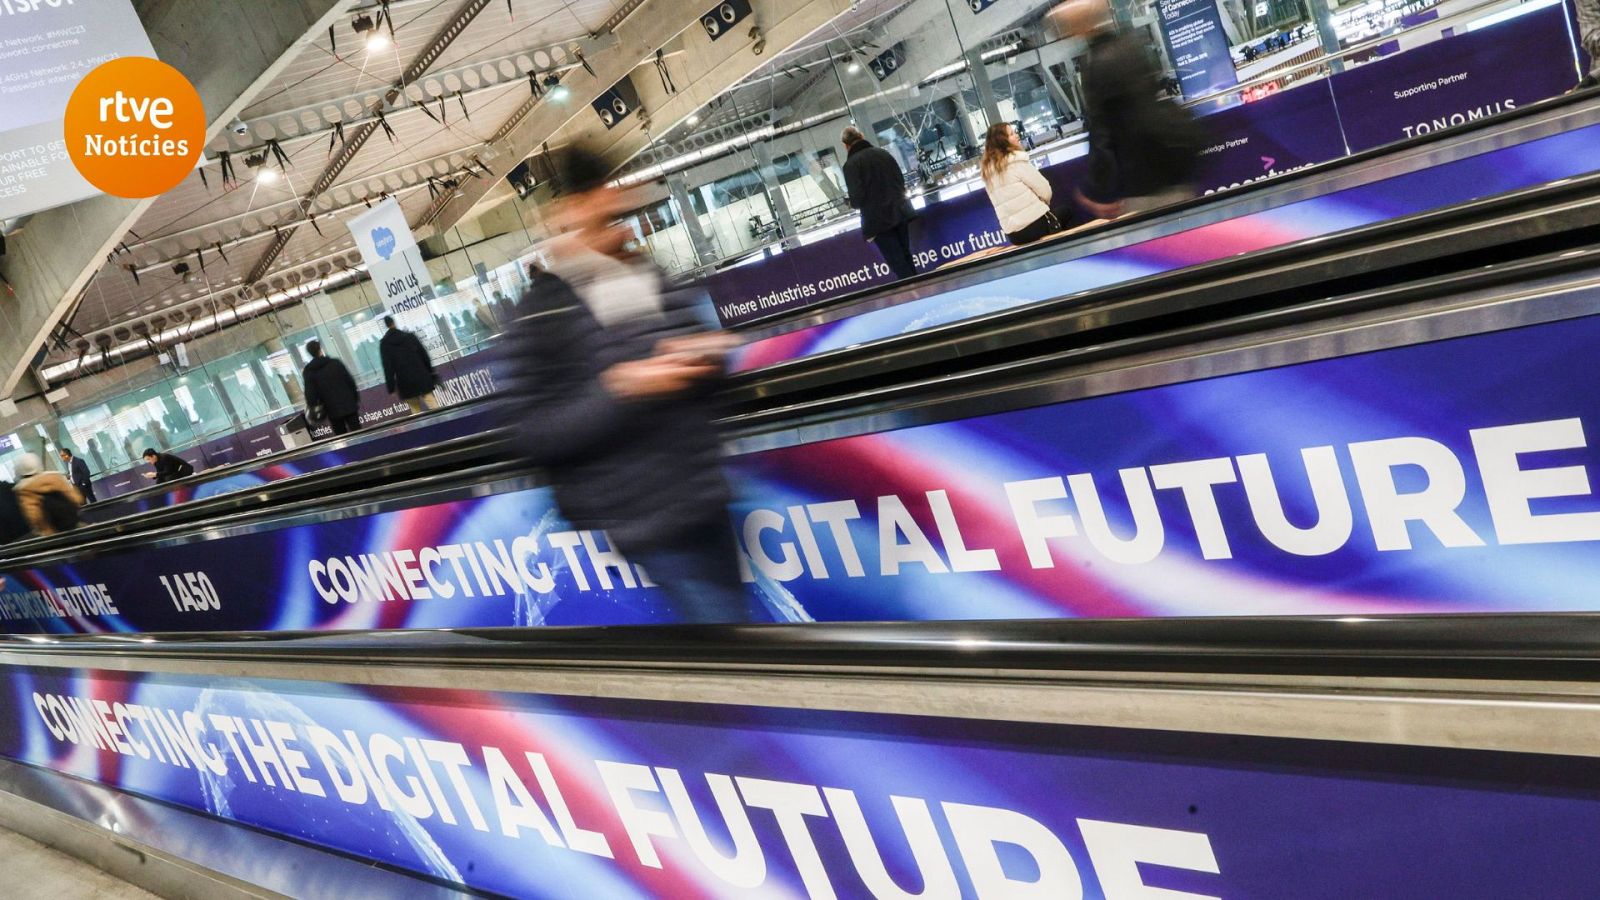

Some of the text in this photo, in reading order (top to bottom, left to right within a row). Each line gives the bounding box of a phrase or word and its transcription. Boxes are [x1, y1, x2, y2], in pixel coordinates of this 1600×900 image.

[32, 38, 80, 52] connectme
[1394, 72, 1468, 99] Supporting Partner
[28, 144, 46, 155] TO
[1226, 136, 1248, 148] Partner
[18, 167, 48, 181] FREE
[385, 272, 419, 298] Join us
[720, 229, 1007, 320] Where industries connect to ape our futur
[364, 410, 382, 423] shape
[382, 406, 394, 417] our
[308, 534, 556, 605] CONNECTING
[1003, 418, 1600, 569] FUTURE
[56, 584, 120, 618] FUTURE
[159, 571, 221, 613] 1A50
[32, 692, 229, 777] CONNECTING
[214, 714, 327, 798] THE
[306, 725, 615, 860] DIGITAL
